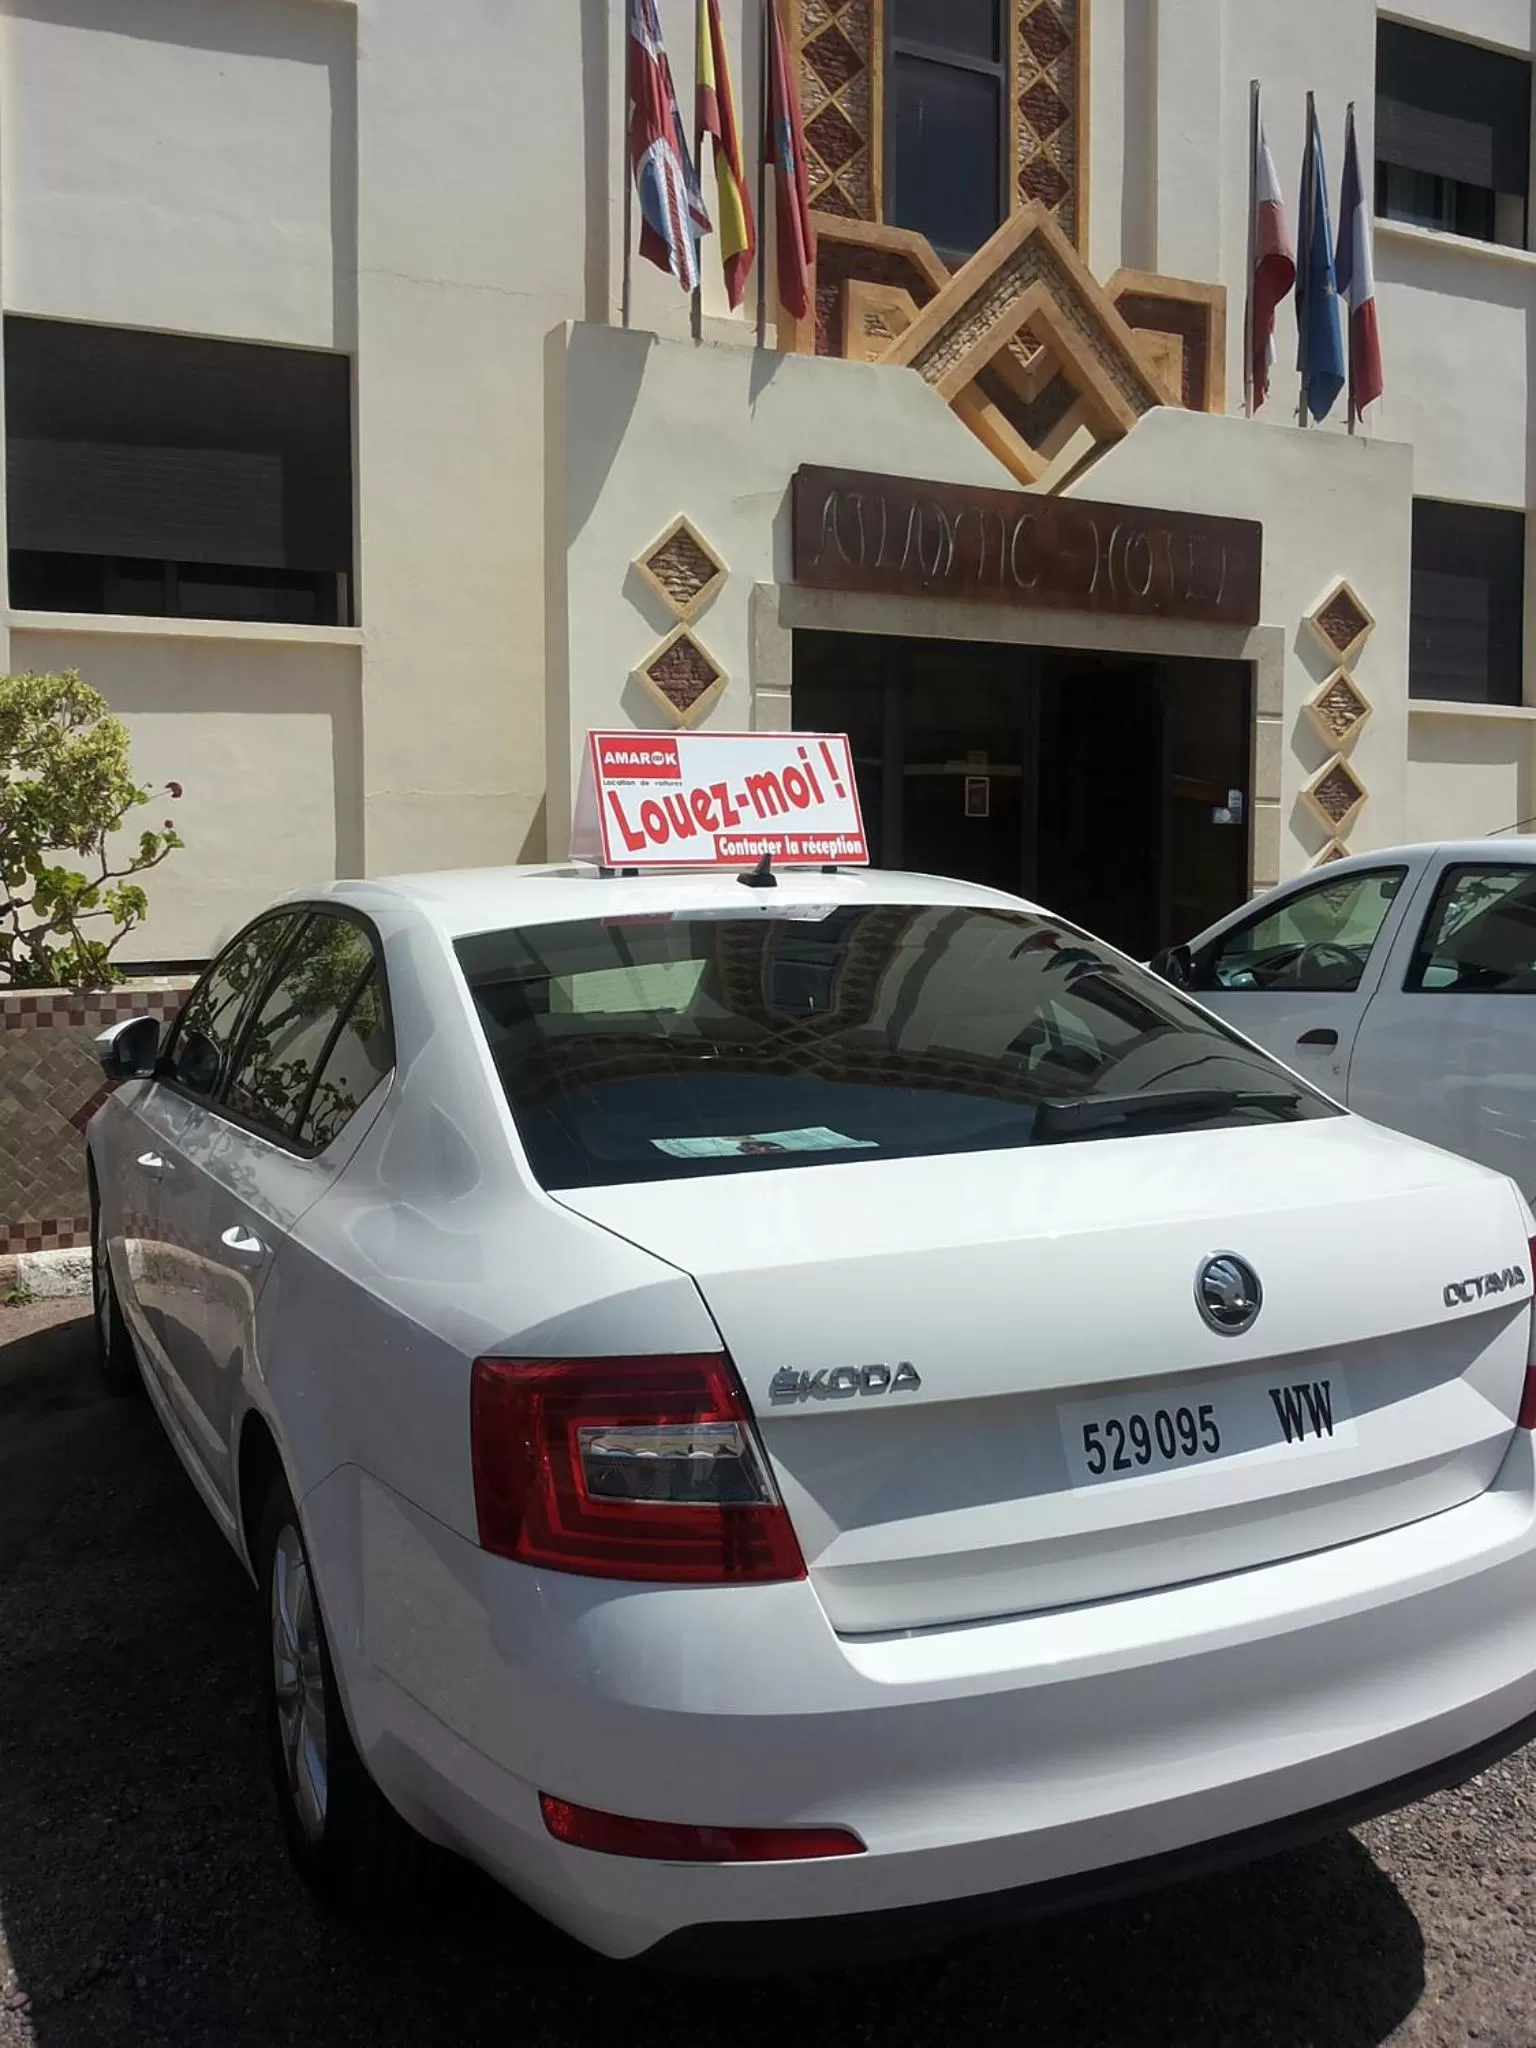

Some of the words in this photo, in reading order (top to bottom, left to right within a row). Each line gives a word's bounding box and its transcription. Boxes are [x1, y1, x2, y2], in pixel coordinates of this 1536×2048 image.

[604, 751, 677, 766] AMAROK
[720, 837, 782, 856] Contacter
[784, 834, 800, 855] la
[802, 835, 863, 860] réception
[1443, 1265, 1526, 1307] OCTAVIA
[1083, 1404, 1220, 1475] 529095
[1268, 1380, 1333, 1445] WW
